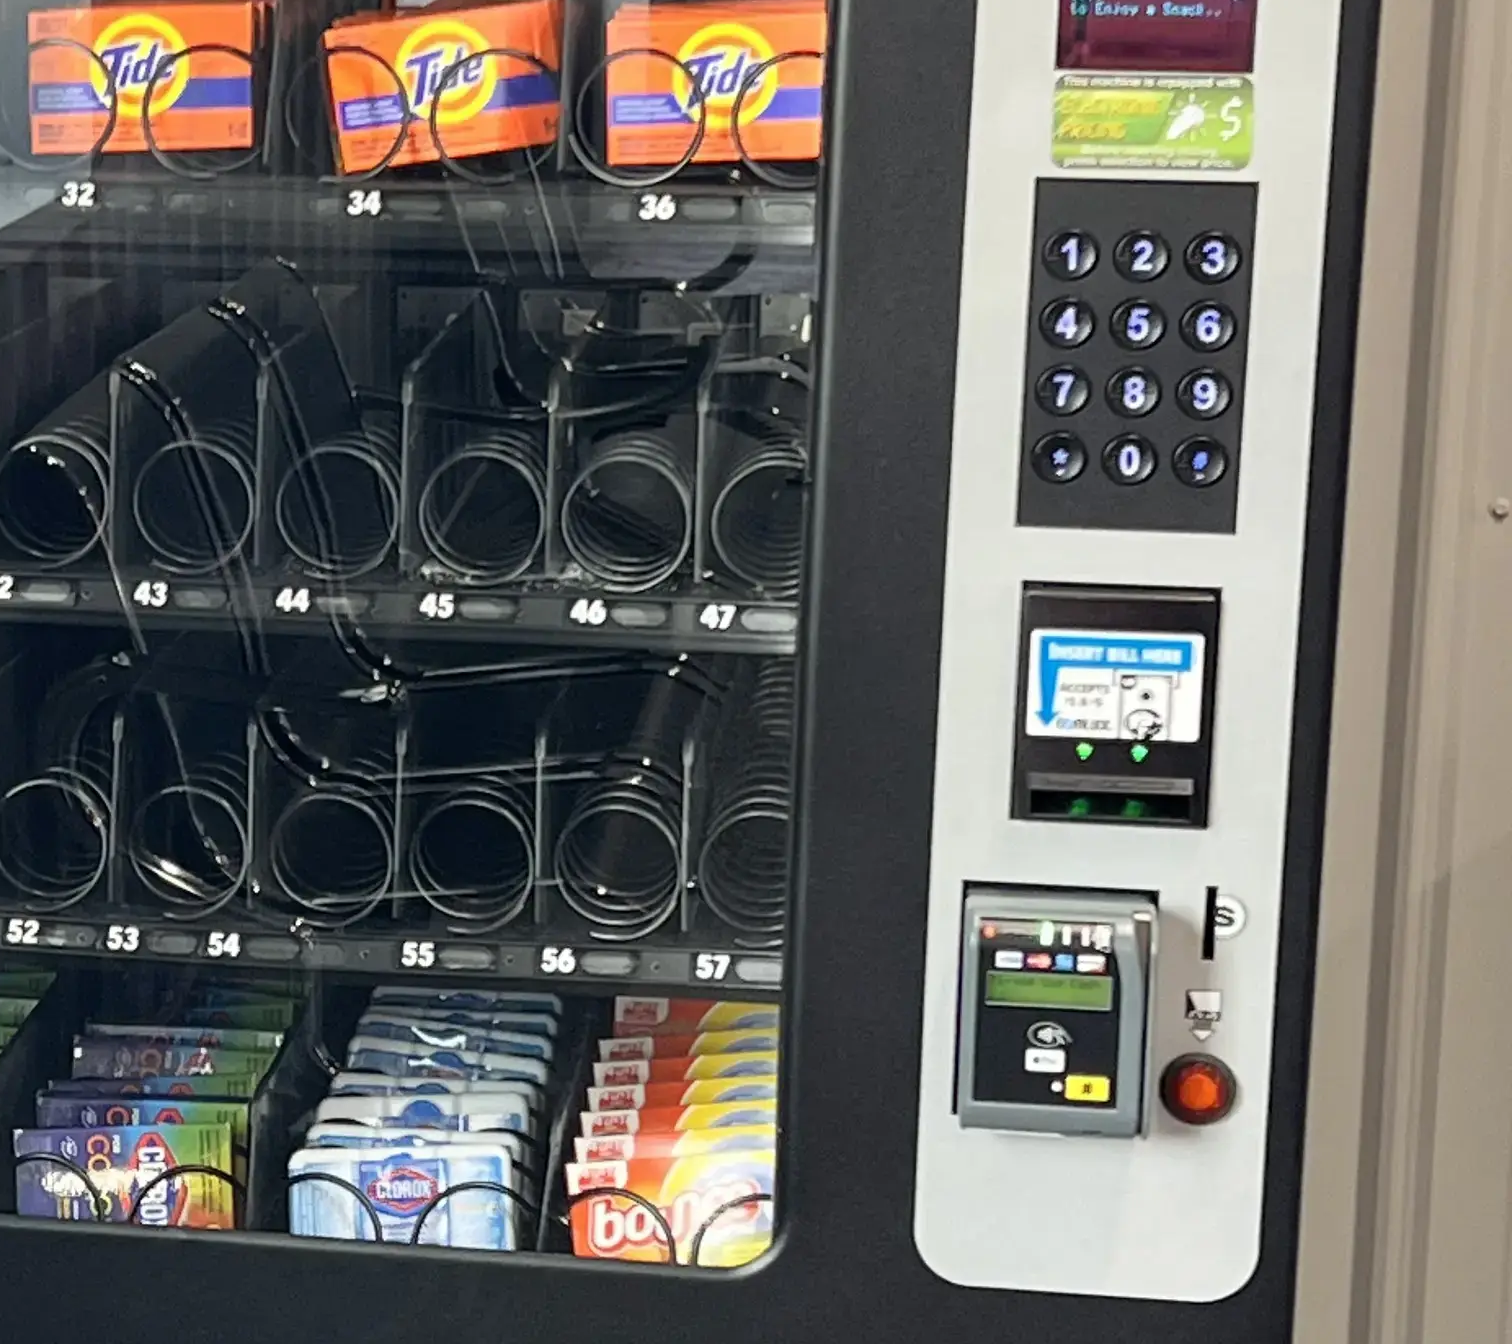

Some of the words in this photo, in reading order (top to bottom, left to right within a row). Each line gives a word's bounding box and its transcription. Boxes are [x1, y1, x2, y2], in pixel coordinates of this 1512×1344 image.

[100, 43, 174, 97] Tide
[405, 47, 484, 107] Tide
[683, 52, 764, 108] Tide
[61, 181, 96, 207] 32
[347, 189, 382, 215] 34
[638, 193, 676, 220] 36
[1060, 237, 1078, 271] 1
[1131, 240, 1154, 271] 2
[1201, 241, 1225, 275] 3
[1054, 306, 1078, 340] 4
[1127, 307, 1150, 341] 5
[1196, 310, 1221, 343] 6
[1052, 374, 1074, 407] 7
[1122, 376, 1146, 409] 8
[1193, 377, 1217, 411] 9
[1119, 444, 1141, 476] 0
[133, 580, 169, 607] 43
[275, 587, 310, 613] 44
[419, 592, 455, 618] 45
[570, 598, 607, 626] 46
[699, 603, 737, 630] 47
[6, 918, 40, 944] 52
[106, 925, 140, 951] 53
[206, 932, 241, 958] 54
[401, 941, 435, 968] 55
[540, 947, 576, 974] 56
[695, 954, 732, 980] 57
[373, 1180, 433, 1200] CLOROX
